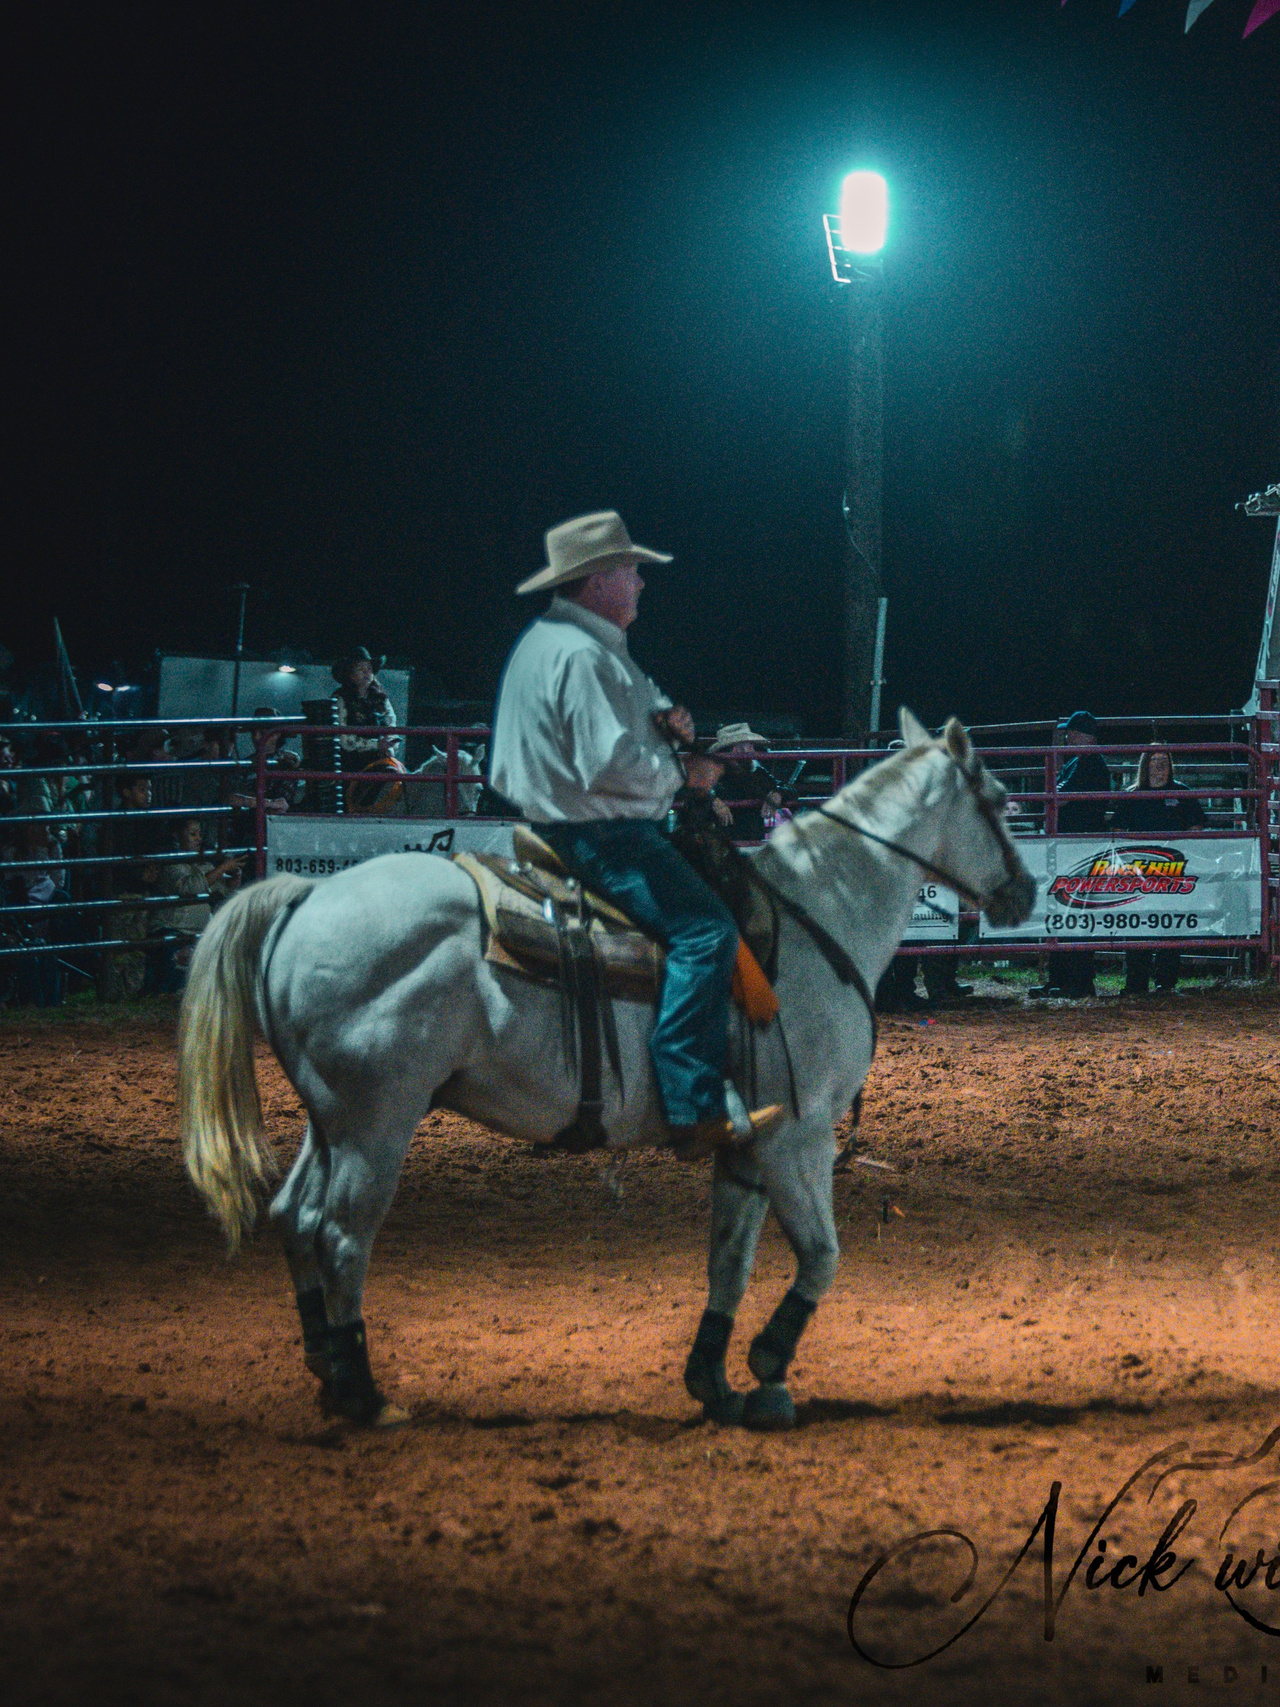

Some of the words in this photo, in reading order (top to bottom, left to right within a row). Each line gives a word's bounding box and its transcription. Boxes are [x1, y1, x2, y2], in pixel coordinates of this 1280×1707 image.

[1090, 860, 1147, 877] Rock
[1147, 860, 1186, 877] Hill
[1050, 876, 1198, 895] POWERSPORTS
[1045, 913, 1199, 934] (803)-980-9076
